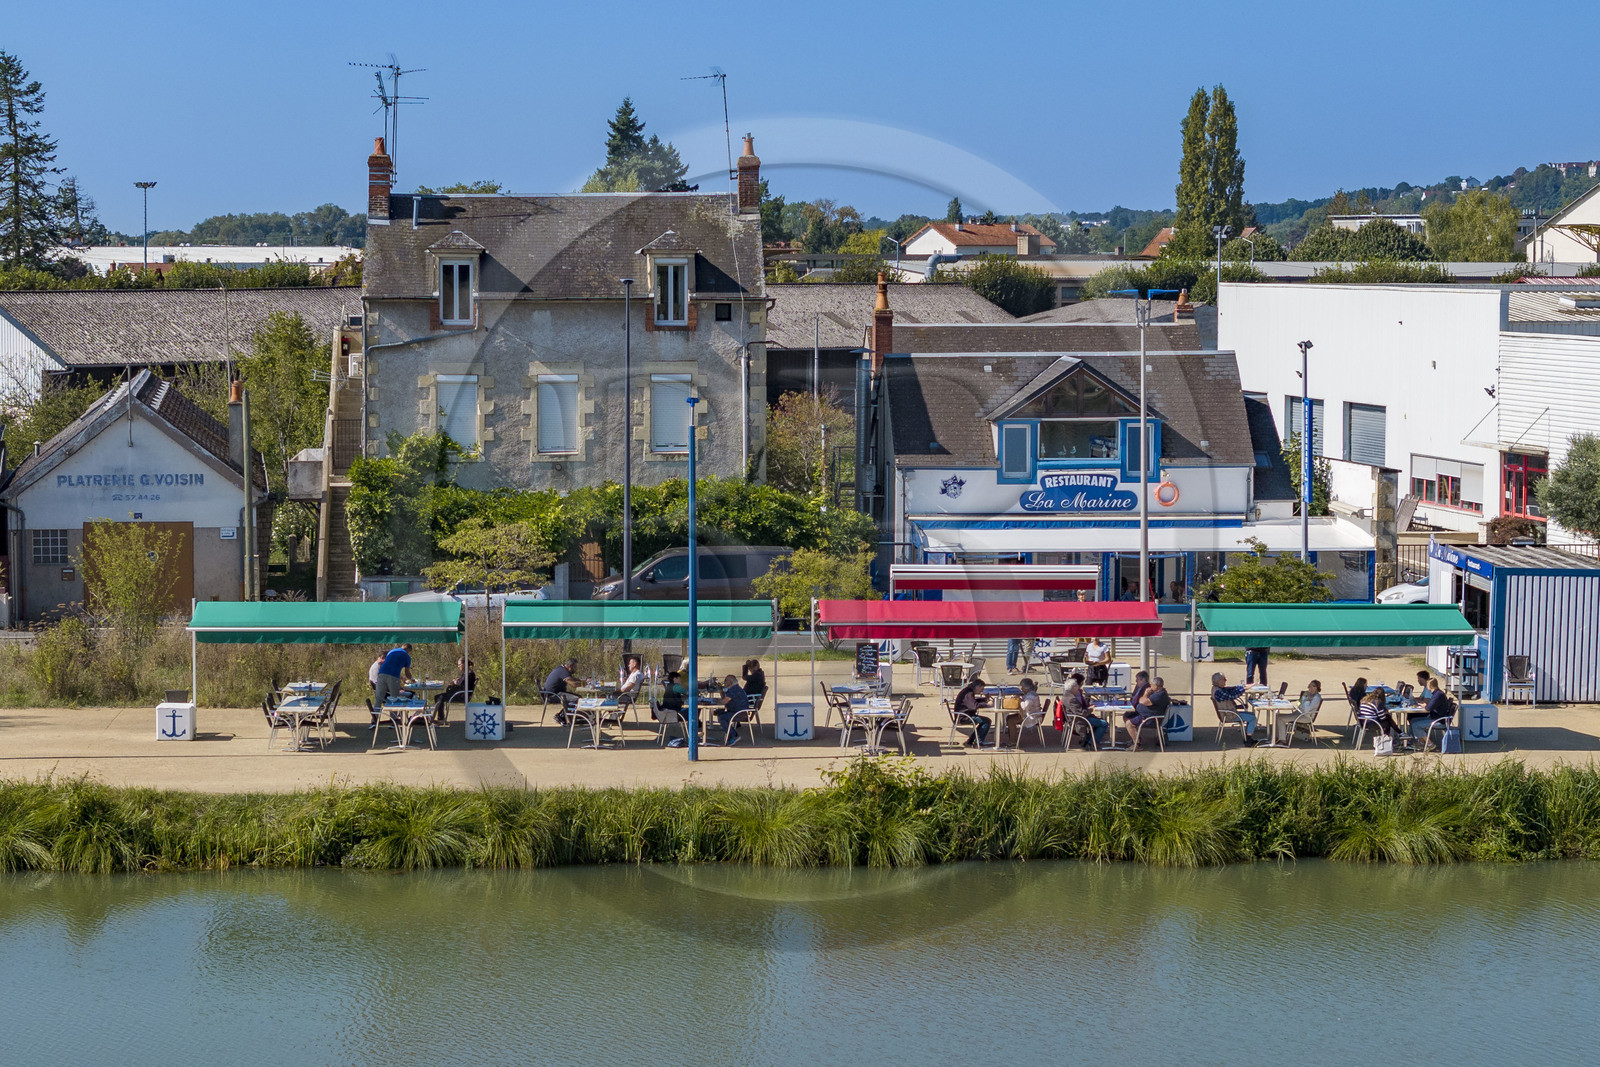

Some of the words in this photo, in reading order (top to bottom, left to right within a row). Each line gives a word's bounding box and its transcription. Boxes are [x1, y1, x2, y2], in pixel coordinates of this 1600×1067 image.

[1044, 475, 1114, 488] RESTAURANT
[1025, 492, 1055, 510] La
[1060, 491, 1132, 509] Marine
